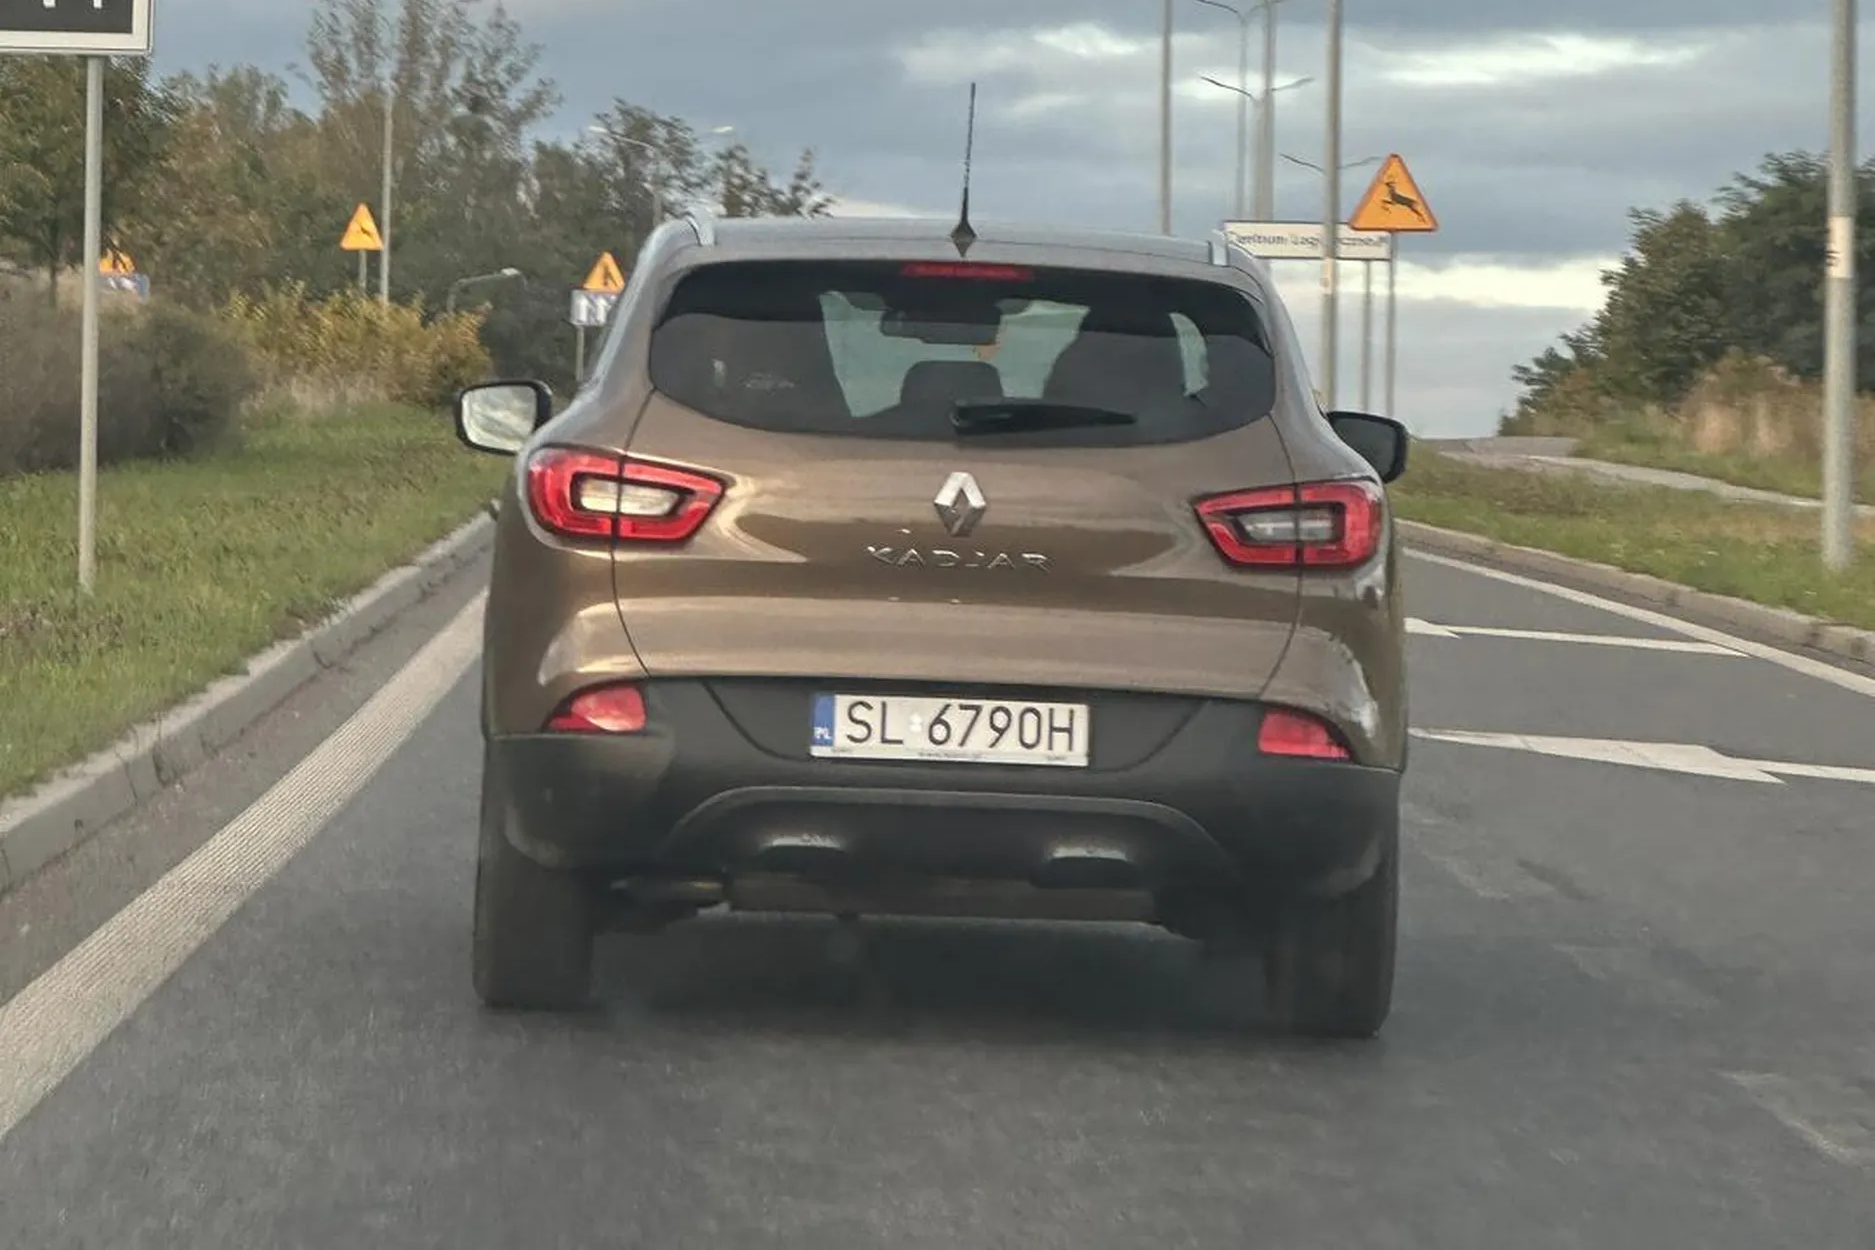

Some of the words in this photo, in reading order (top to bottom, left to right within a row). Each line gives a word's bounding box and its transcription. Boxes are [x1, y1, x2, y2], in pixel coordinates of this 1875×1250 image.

[867, 545, 1051, 572] KADJAR
[813, 726, 833, 740] PL
[846, 701, 903, 743] SL
[928, 703, 1075, 752] 6790H
